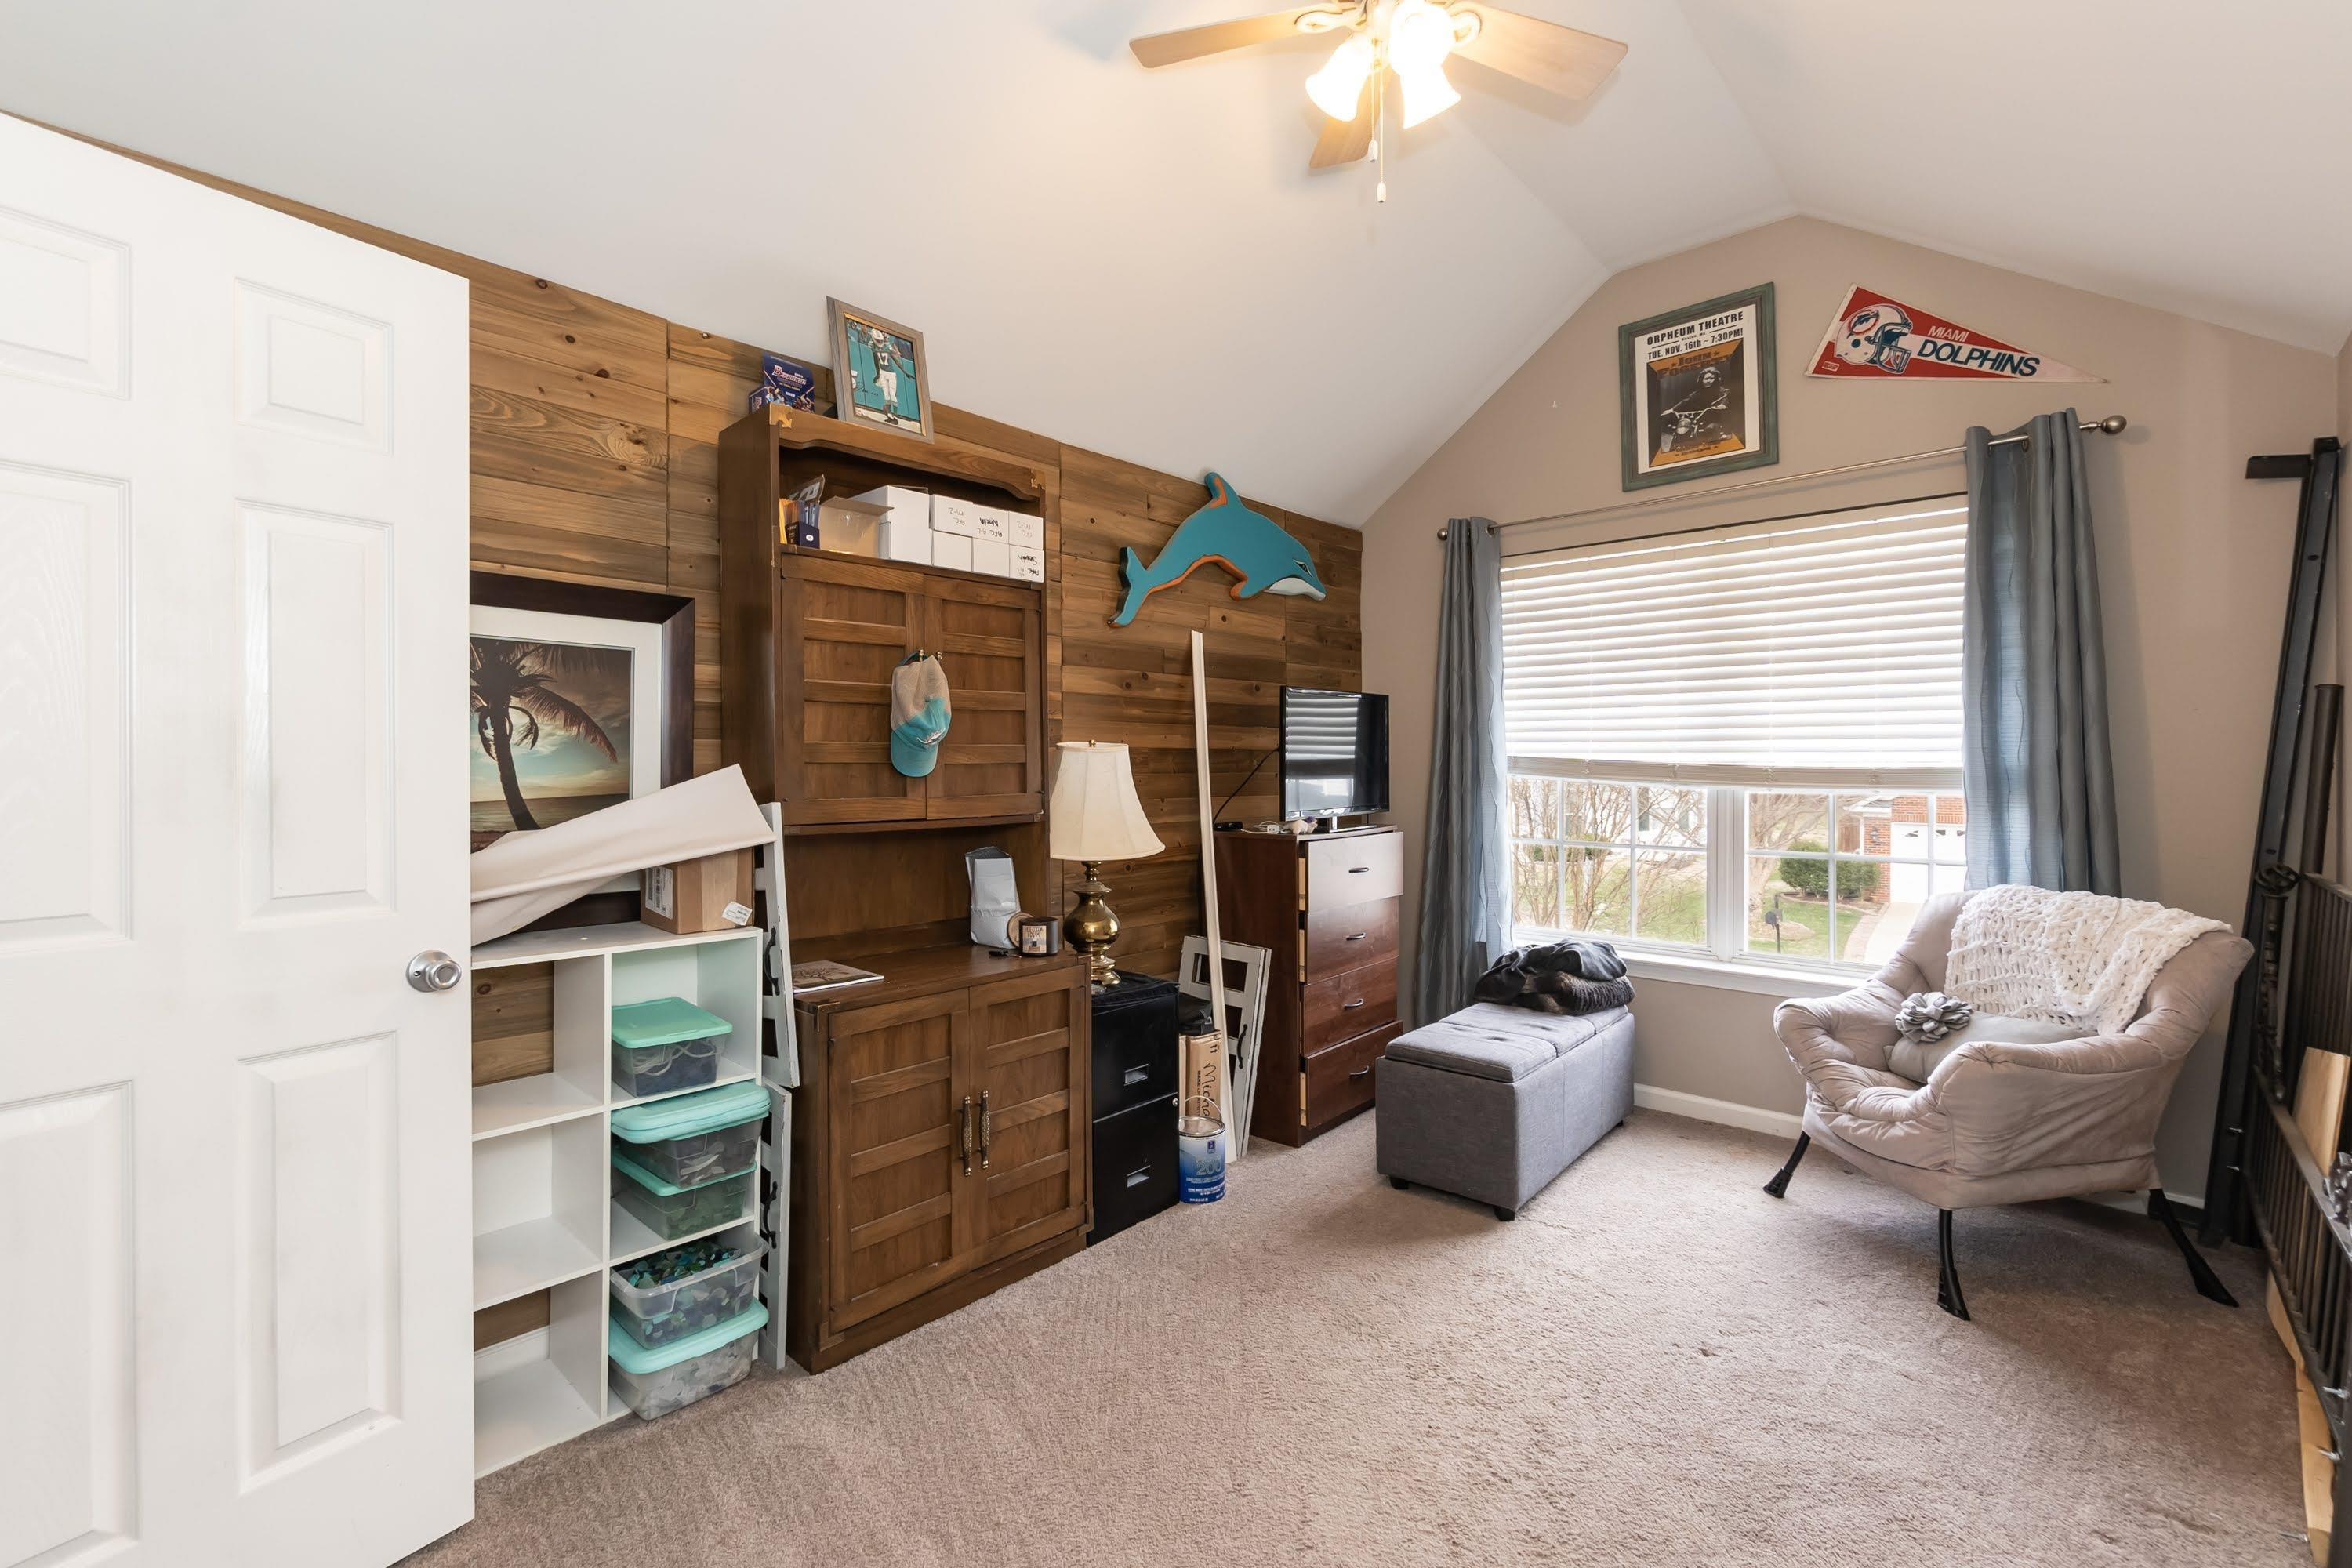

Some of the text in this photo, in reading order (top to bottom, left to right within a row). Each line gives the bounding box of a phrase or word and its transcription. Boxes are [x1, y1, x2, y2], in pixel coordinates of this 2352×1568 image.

[1647, 311, 1744, 346] ORPHEUM THEATRE
[1927, 325, 1969, 343] MIAMI
[1648, 350, 1664, 360] TUE.
[1665, 344, 1682, 356] NOV.
[1685, 339, 1701, 350] 16th
[1711, 328, 1744, 343] 7:30PM!
[877, 352, 889, 365] 17
[1918, 339, 2040, 377] DOLPHINS
[1196, 1160, 1222, 1176] 200
